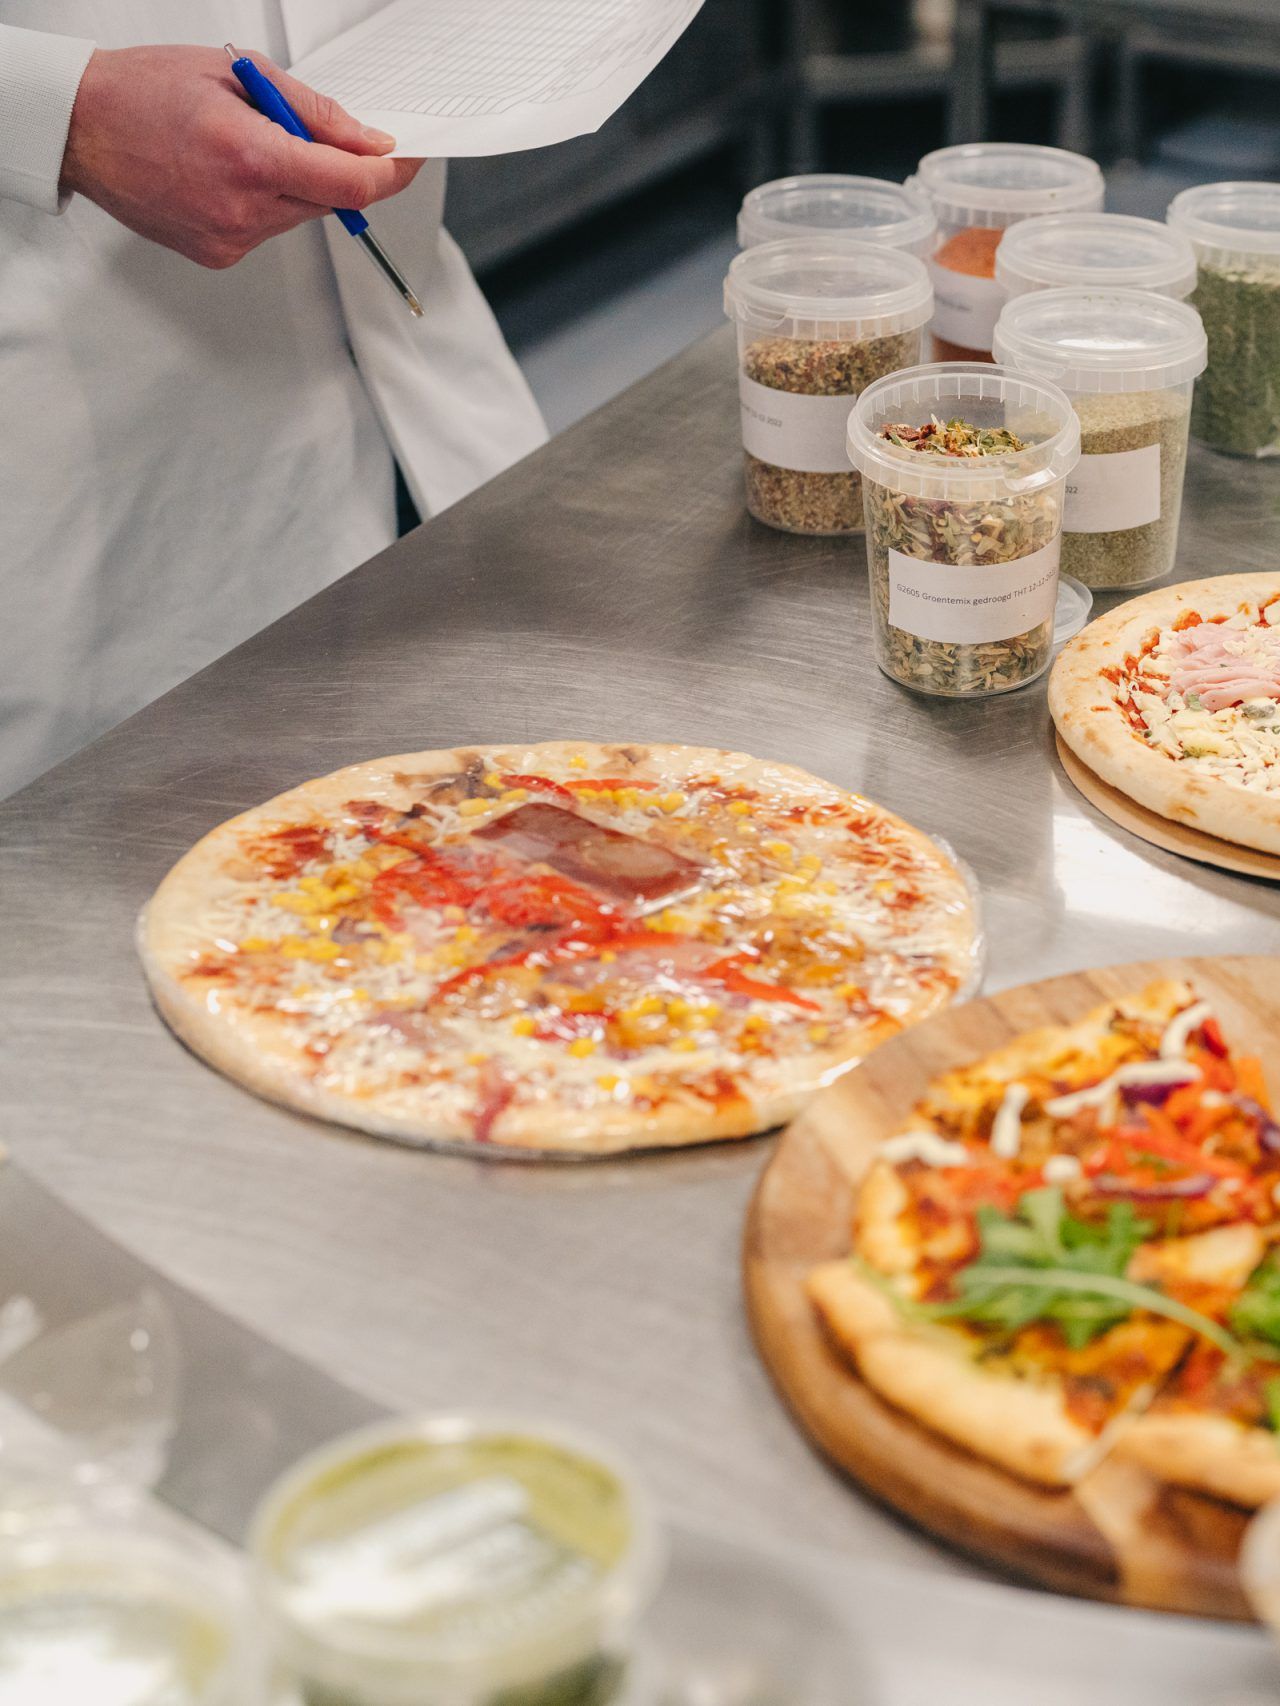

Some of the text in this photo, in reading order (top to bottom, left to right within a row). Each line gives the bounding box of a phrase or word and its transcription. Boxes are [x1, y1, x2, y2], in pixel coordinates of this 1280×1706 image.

[896, 583, 920, 598] G2605
[922, 592, 971, 605] Groentemix
[972, 592, 1012, 606] gedroogd
[1014, 587, 1027, 598] THT
